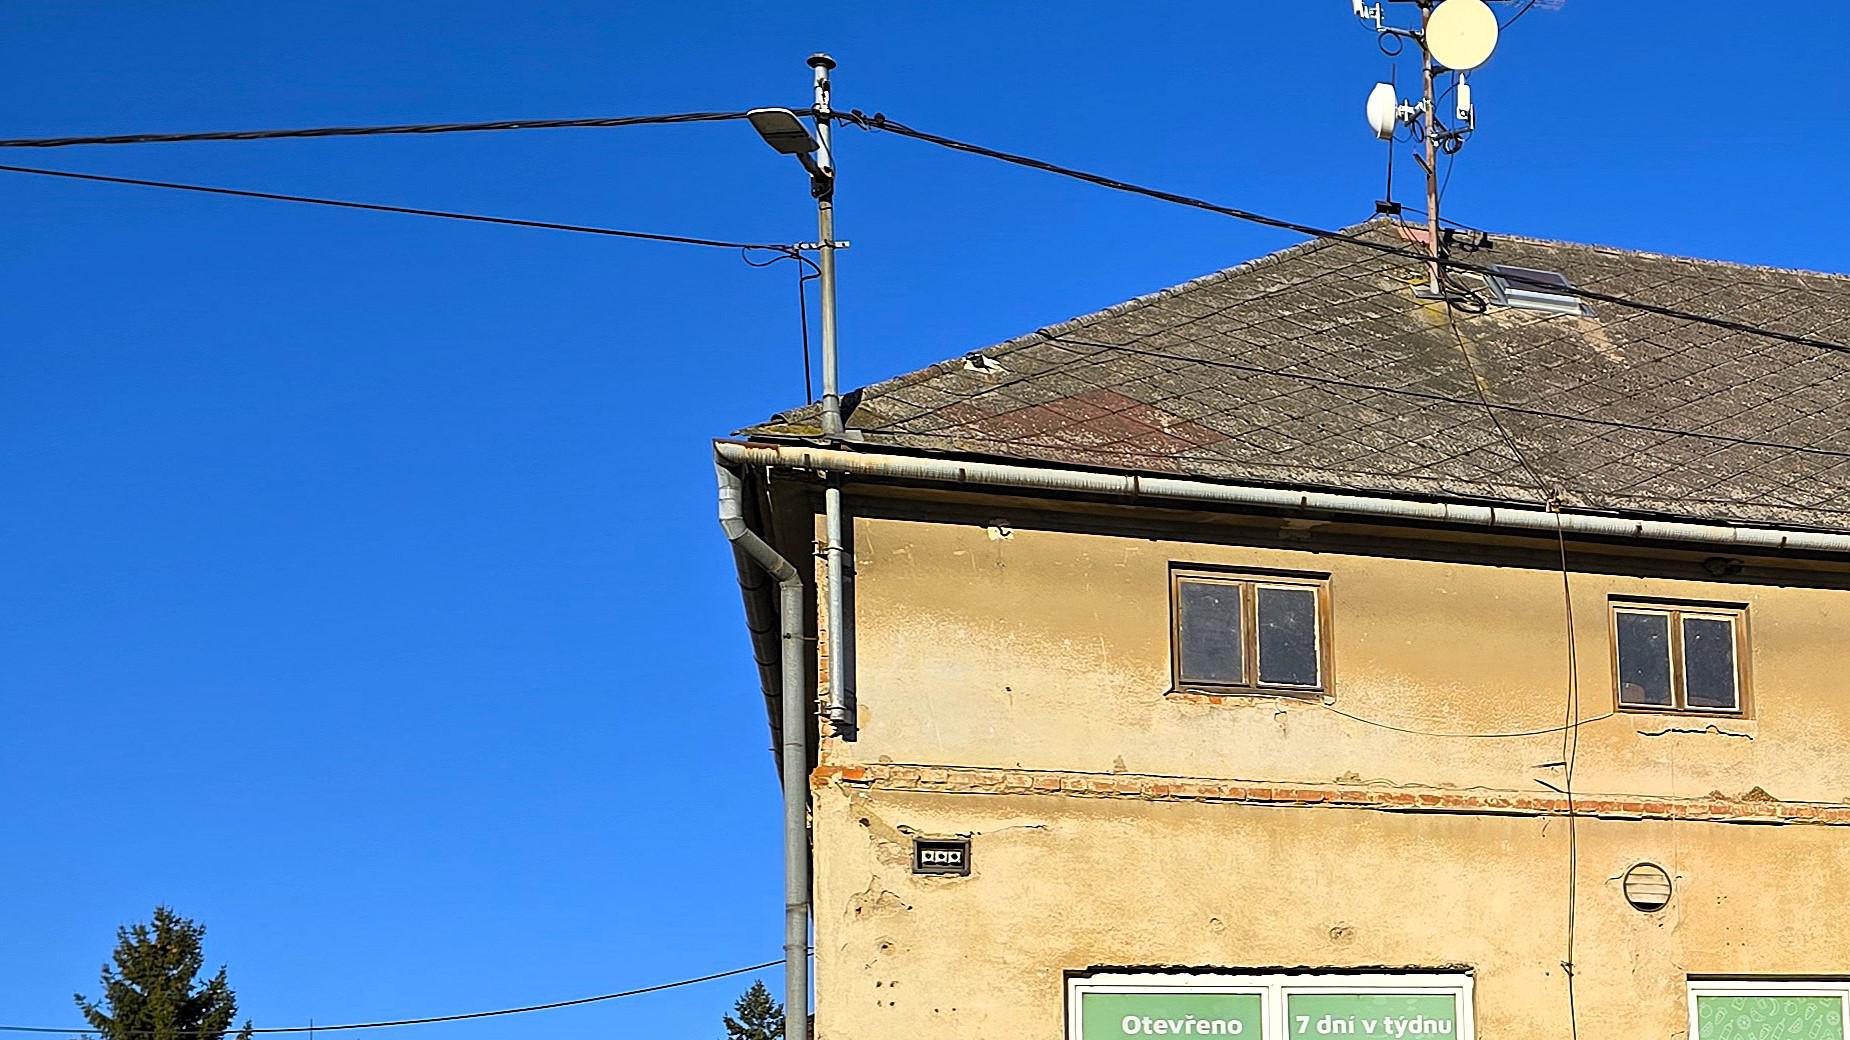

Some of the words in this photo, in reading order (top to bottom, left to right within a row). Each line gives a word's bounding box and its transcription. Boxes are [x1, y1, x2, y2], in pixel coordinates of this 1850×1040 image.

[1121, 1014, 1243, 1035] Otevřeno
[1296, 1015, 1310, 1034] 7
[1316, 1014, 1355, 1034] dní
[1362, 1019, 1377, 1034] v
[1383, 1014, 1452, 1038] týdnu
